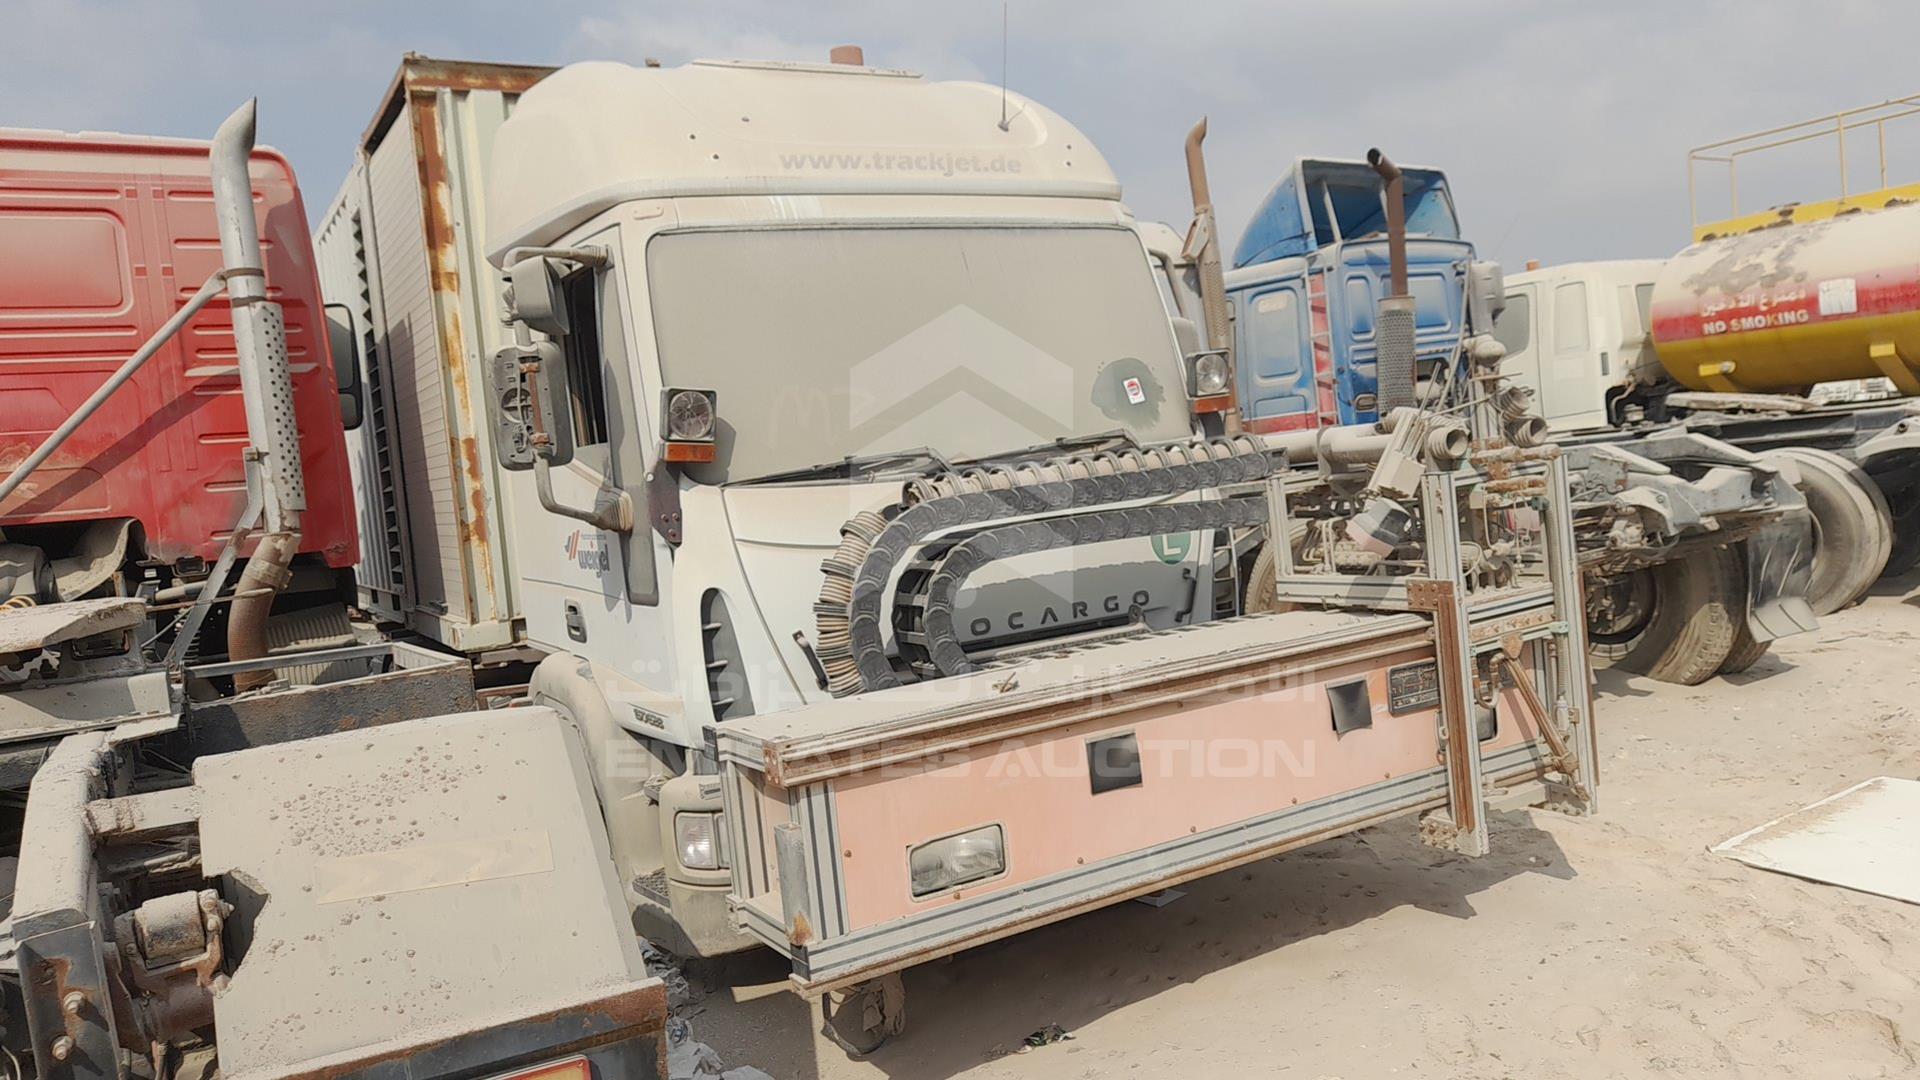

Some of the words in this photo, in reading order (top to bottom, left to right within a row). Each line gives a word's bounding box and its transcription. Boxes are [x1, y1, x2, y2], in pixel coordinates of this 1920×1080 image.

[780, 151, 1022, 177] www.trackjet.de
[1702, 319, 1728, 335] NO
[1729, 309, 1809, 332] SMOKING
[1162, 533, 1181, 556] L
[970, 590, 1150, 637] OCARGO
